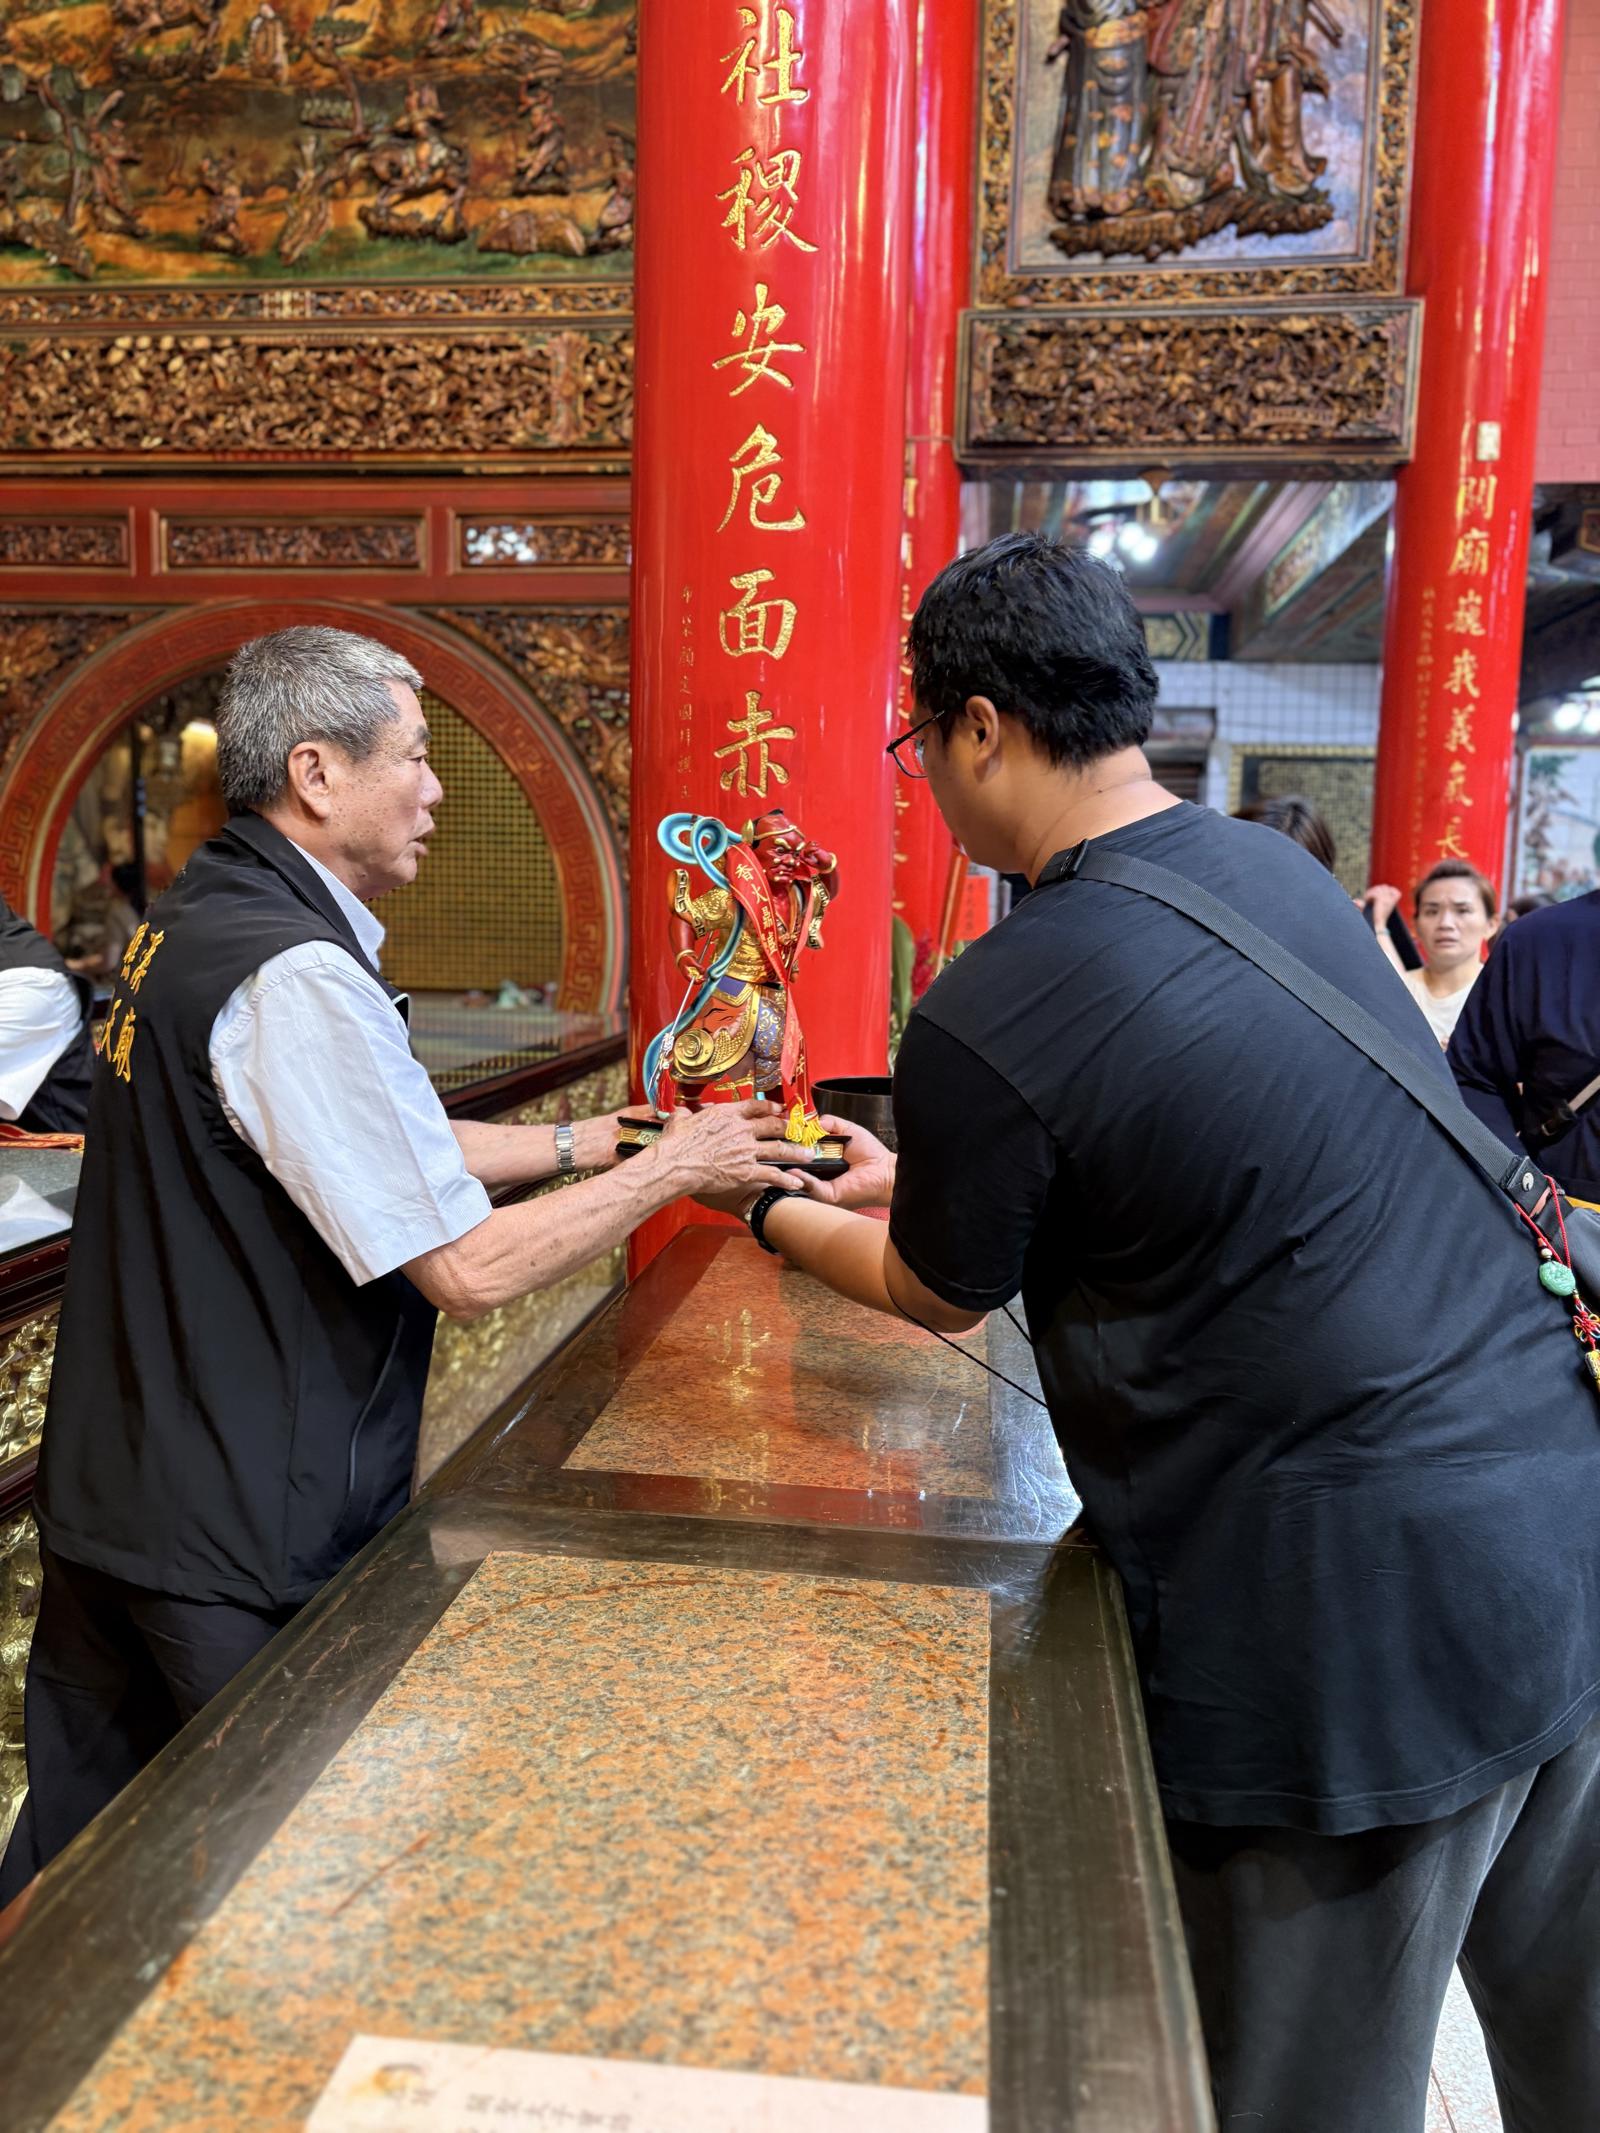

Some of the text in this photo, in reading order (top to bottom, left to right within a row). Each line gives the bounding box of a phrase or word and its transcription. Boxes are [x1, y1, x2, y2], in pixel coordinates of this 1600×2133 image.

[711, 6, 821, 799] 社稷安危面赤
